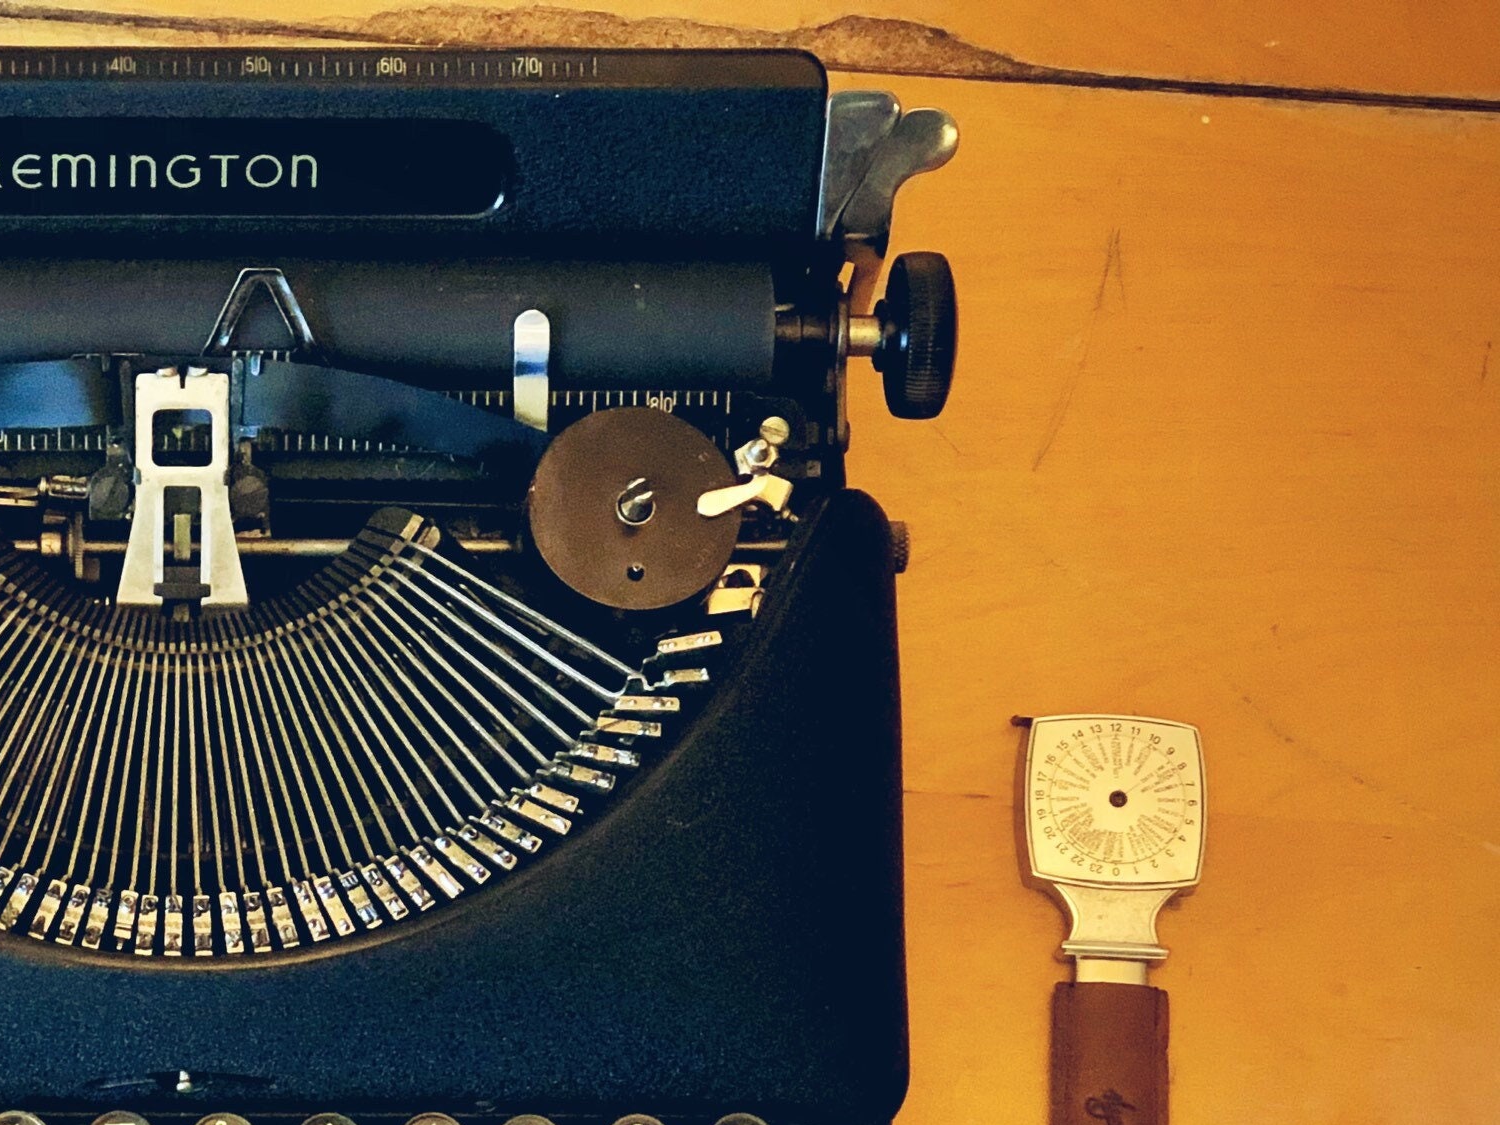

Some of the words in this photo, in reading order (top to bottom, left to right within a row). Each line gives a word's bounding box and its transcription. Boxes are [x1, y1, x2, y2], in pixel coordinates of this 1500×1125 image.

[110, 56, 132, 72] 40
[245, 56, 267, 72] 50
[380, 57, 403, 74] 60
[515, 57, 538, 74] 70
